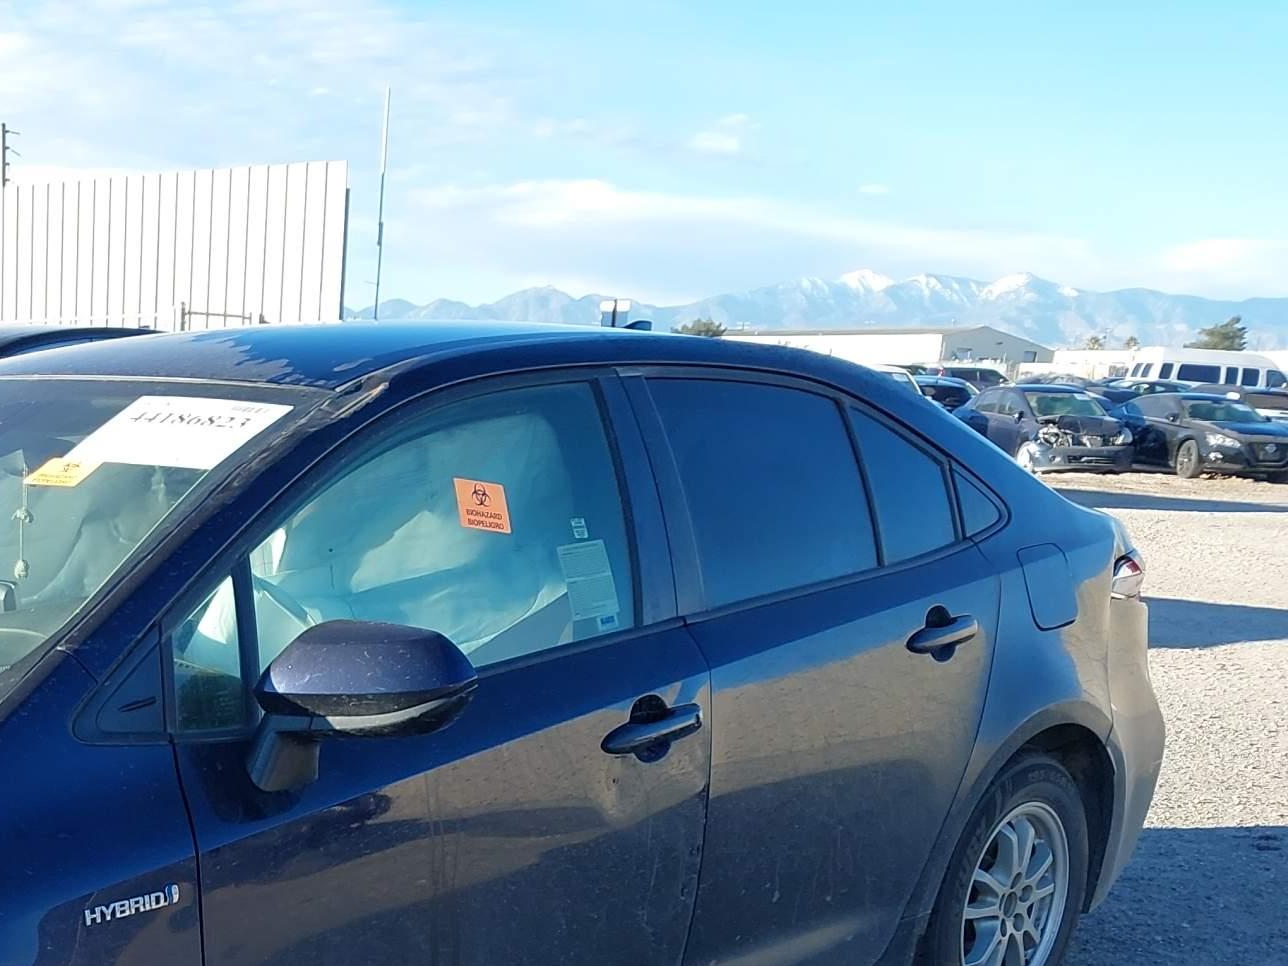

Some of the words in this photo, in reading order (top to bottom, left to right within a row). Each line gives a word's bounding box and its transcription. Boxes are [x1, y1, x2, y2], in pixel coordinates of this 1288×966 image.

[130, 412, 251, 428] 44186823
[465, 509, 503, 521] BIOHAZARD
[467, 517, 504, 530] BIOPELIGRO
[84, 890, 169, 926] HYBRID
